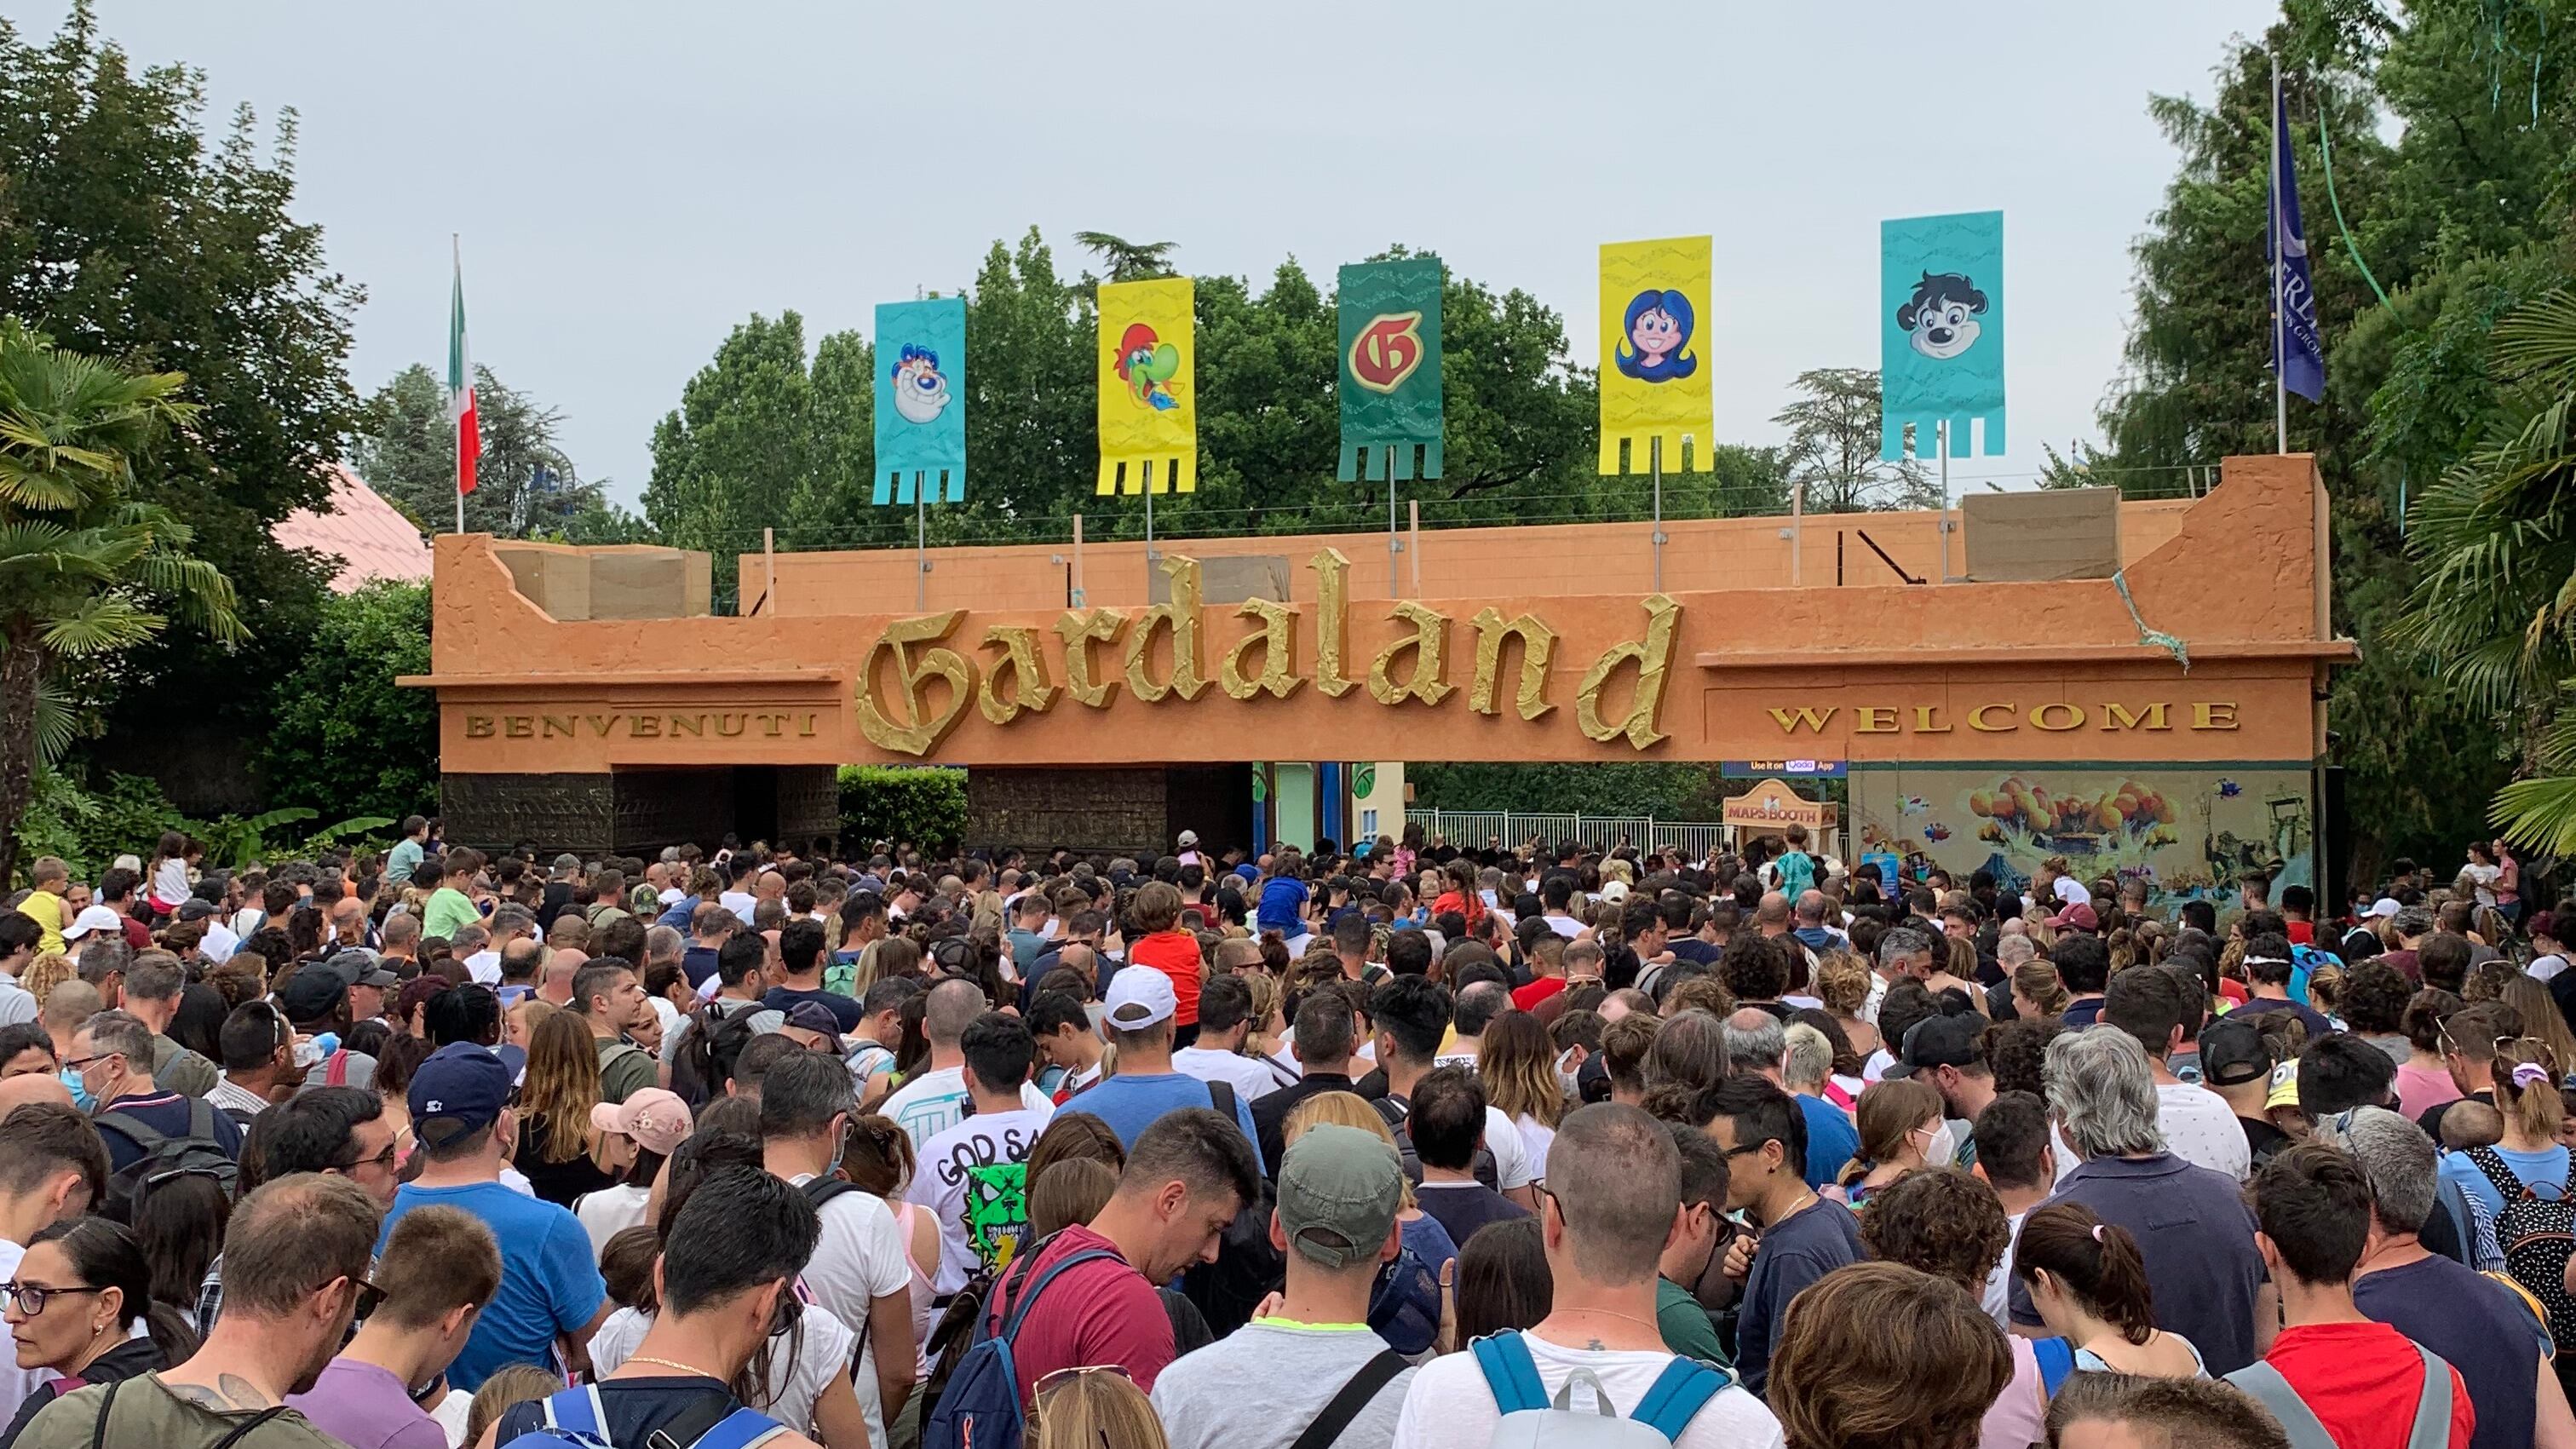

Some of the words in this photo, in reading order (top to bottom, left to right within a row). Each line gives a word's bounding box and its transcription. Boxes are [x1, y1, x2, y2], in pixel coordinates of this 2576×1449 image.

[1353, 314, 1419, 389] G
[855, 547, 1683, 756] Gardaland
[465, 713, 817, 739] BENVENUTI
[1766, 702, 2240, 733] WELCOME
[1751, 761, 1766, 770] Use
[1774, 762, 1785, 770] on
[1818, 761, 1835, 772] App
[1727, 806, 1766, 820] MAPS
[1768, 808, 1817, 823] BOOTH
[938, 1134, 996, 1187] GOD
